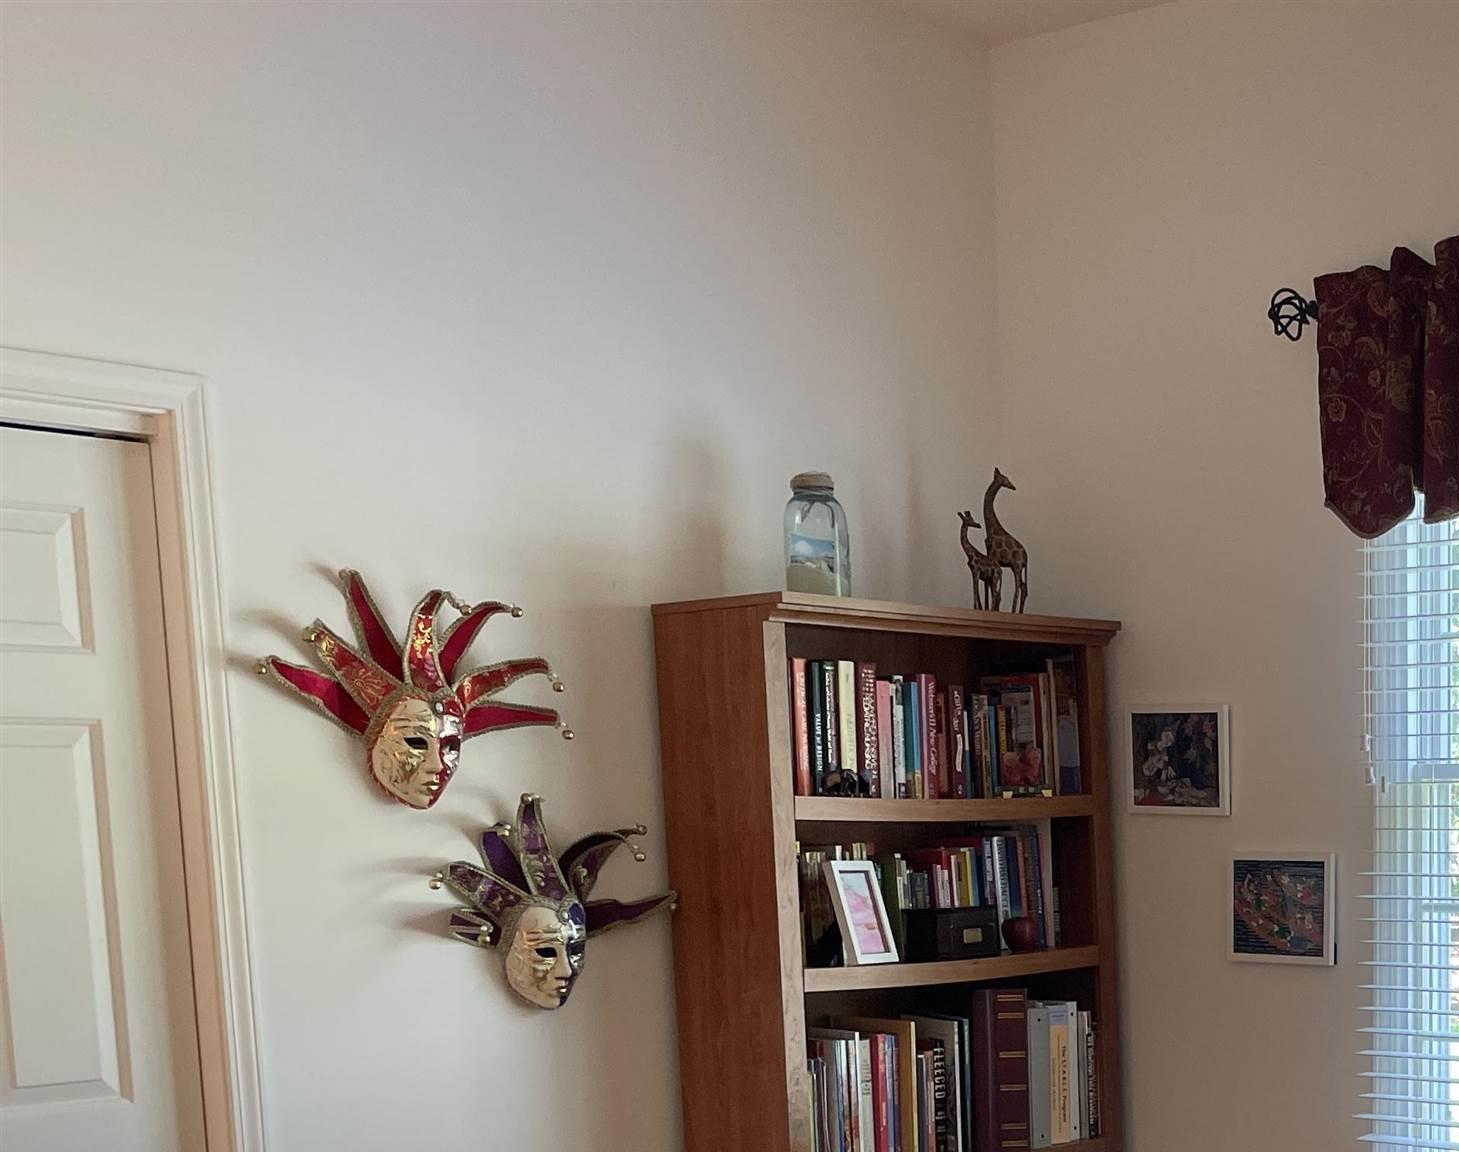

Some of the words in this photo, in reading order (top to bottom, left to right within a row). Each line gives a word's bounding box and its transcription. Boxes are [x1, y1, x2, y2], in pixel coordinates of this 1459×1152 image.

[927, 682, 937, 717] Webster's
[814, 713, 822, 734] VALUE
[929, 727, 937, 746] New
[815, 745, 823, 771] DESIGN
[928, 747, 938, 776] College
[933, 1047, 946, 1099] FLEECED
